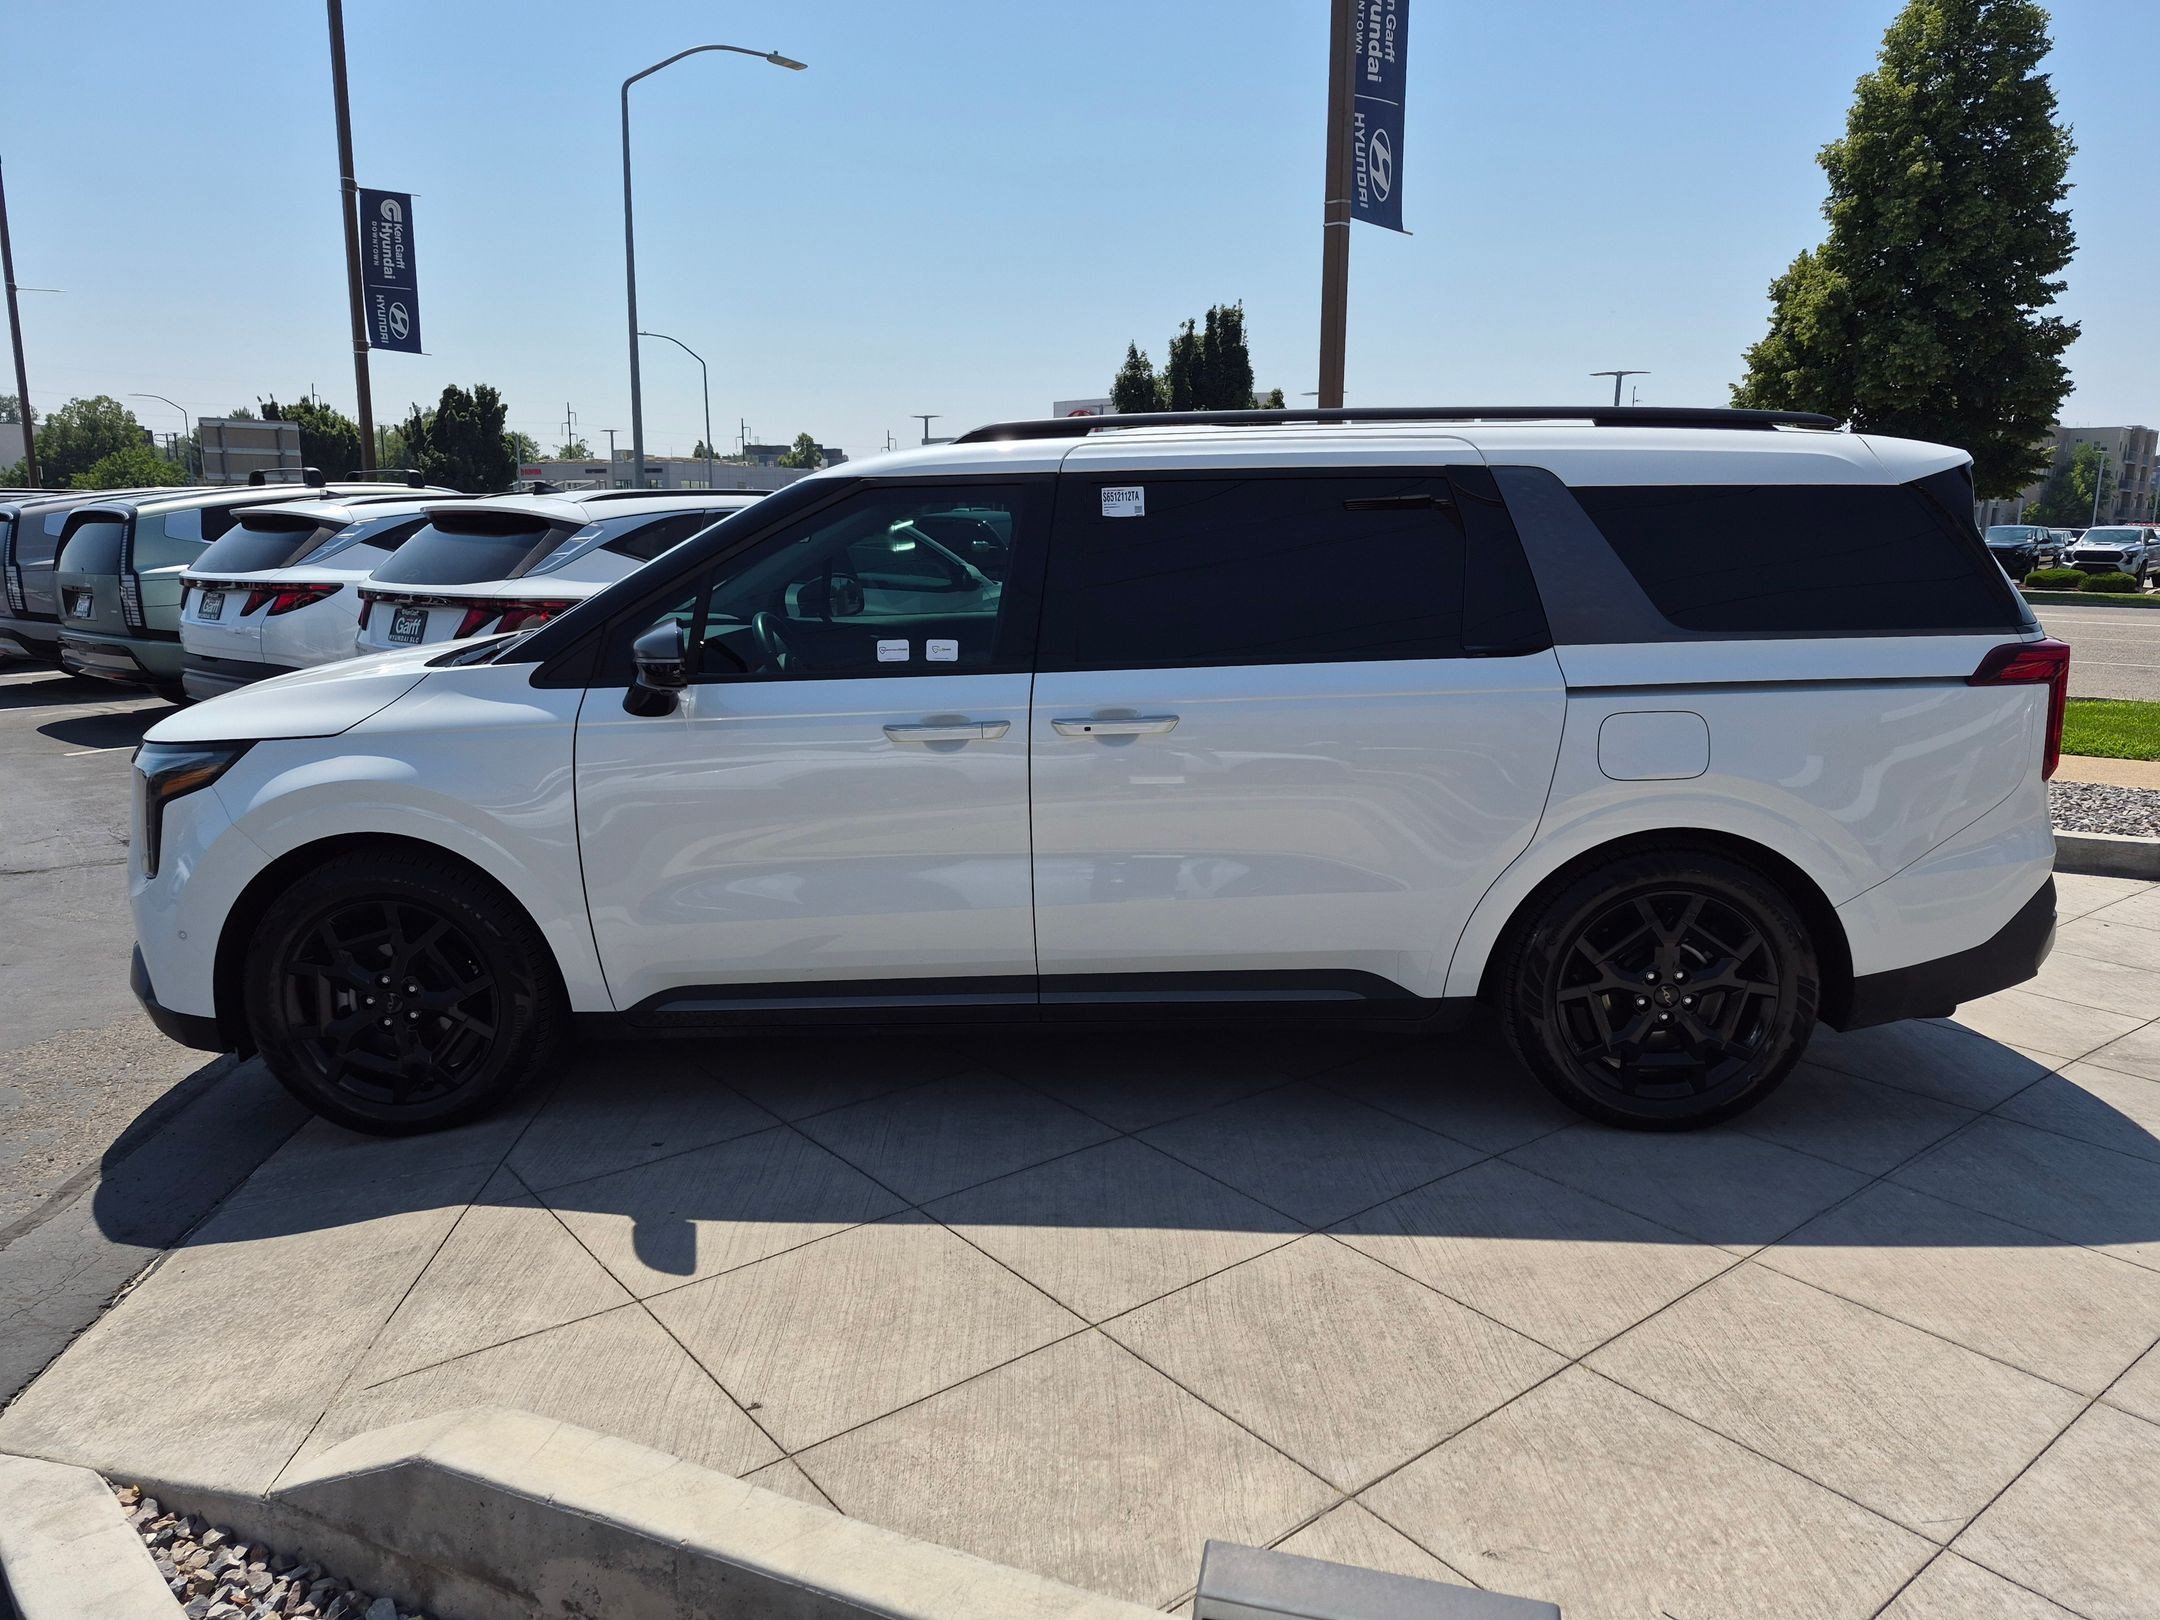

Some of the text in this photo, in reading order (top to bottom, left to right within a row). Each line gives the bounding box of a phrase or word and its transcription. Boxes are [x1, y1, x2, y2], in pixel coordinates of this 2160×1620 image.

[1367, 0, 1382, 82] undai
[1385, 14, 1396, 63] Garff
[1354, 112, 1368, 208] HYUNDAI
[371, 221, 379, 266] DOWNTOWN
[378, 222, 396, 279] Hyundai
[394, 224, 405, 269] Ken Garff
[376, 294, 389, 344] HYUNDAI
[395, 617, 421, 635] Garff
